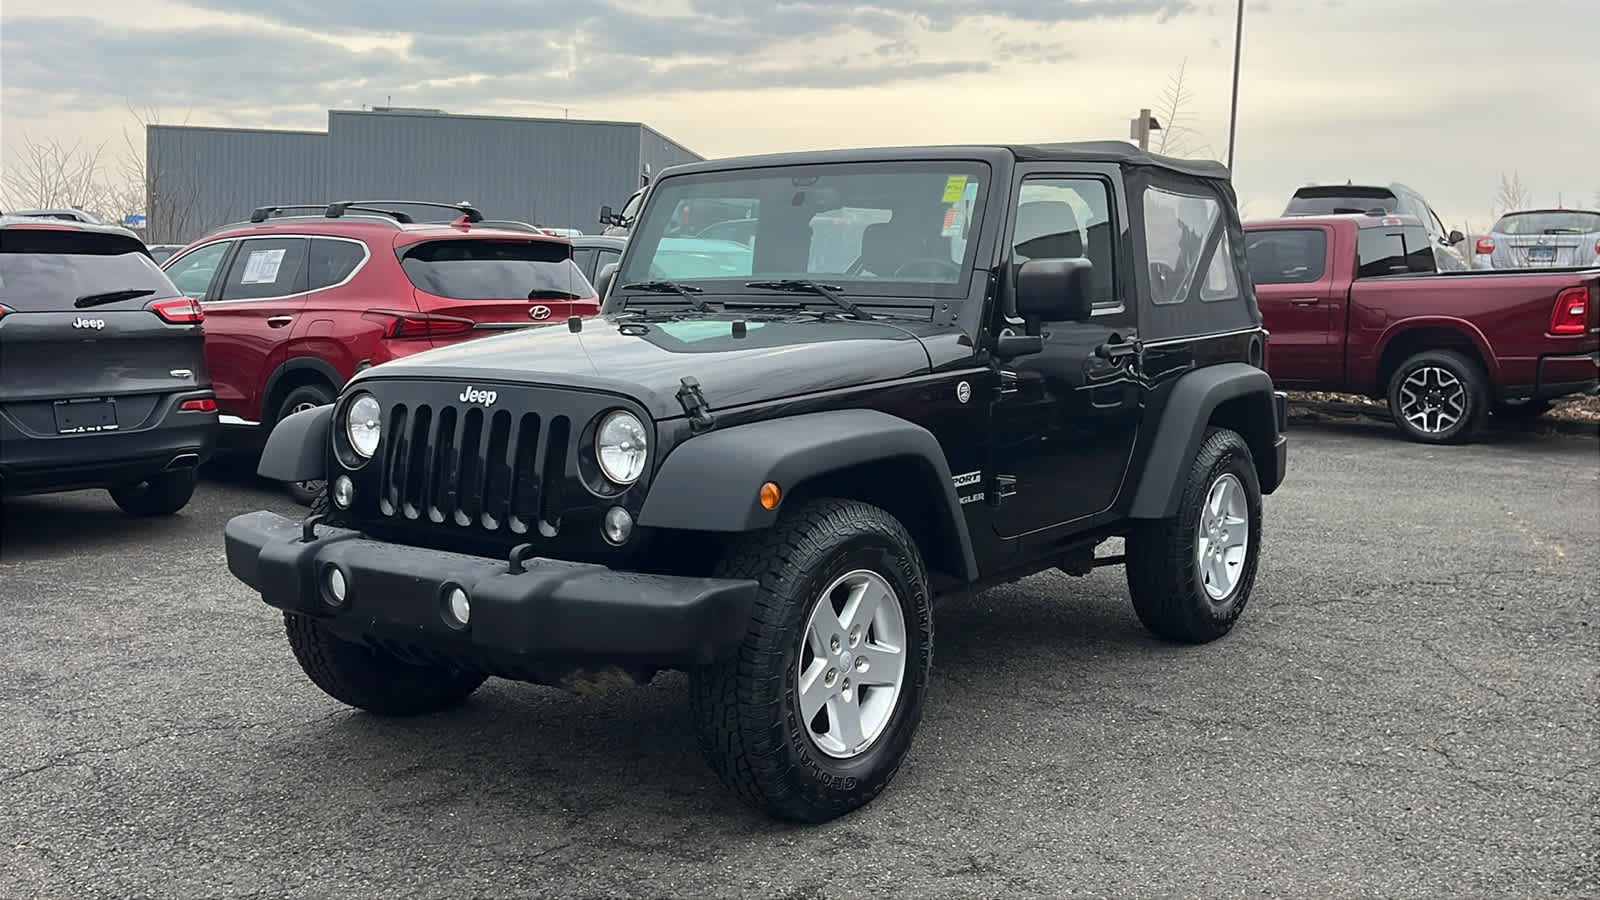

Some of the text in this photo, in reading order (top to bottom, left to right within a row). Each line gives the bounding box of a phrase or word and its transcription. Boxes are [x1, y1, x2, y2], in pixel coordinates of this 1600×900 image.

[72, 317, 105, 330] Jeep
[459, 385, 497, 407] Jeep
[951, 471, 981, 487] PORT
[959, 492, 985, 504] GLER
